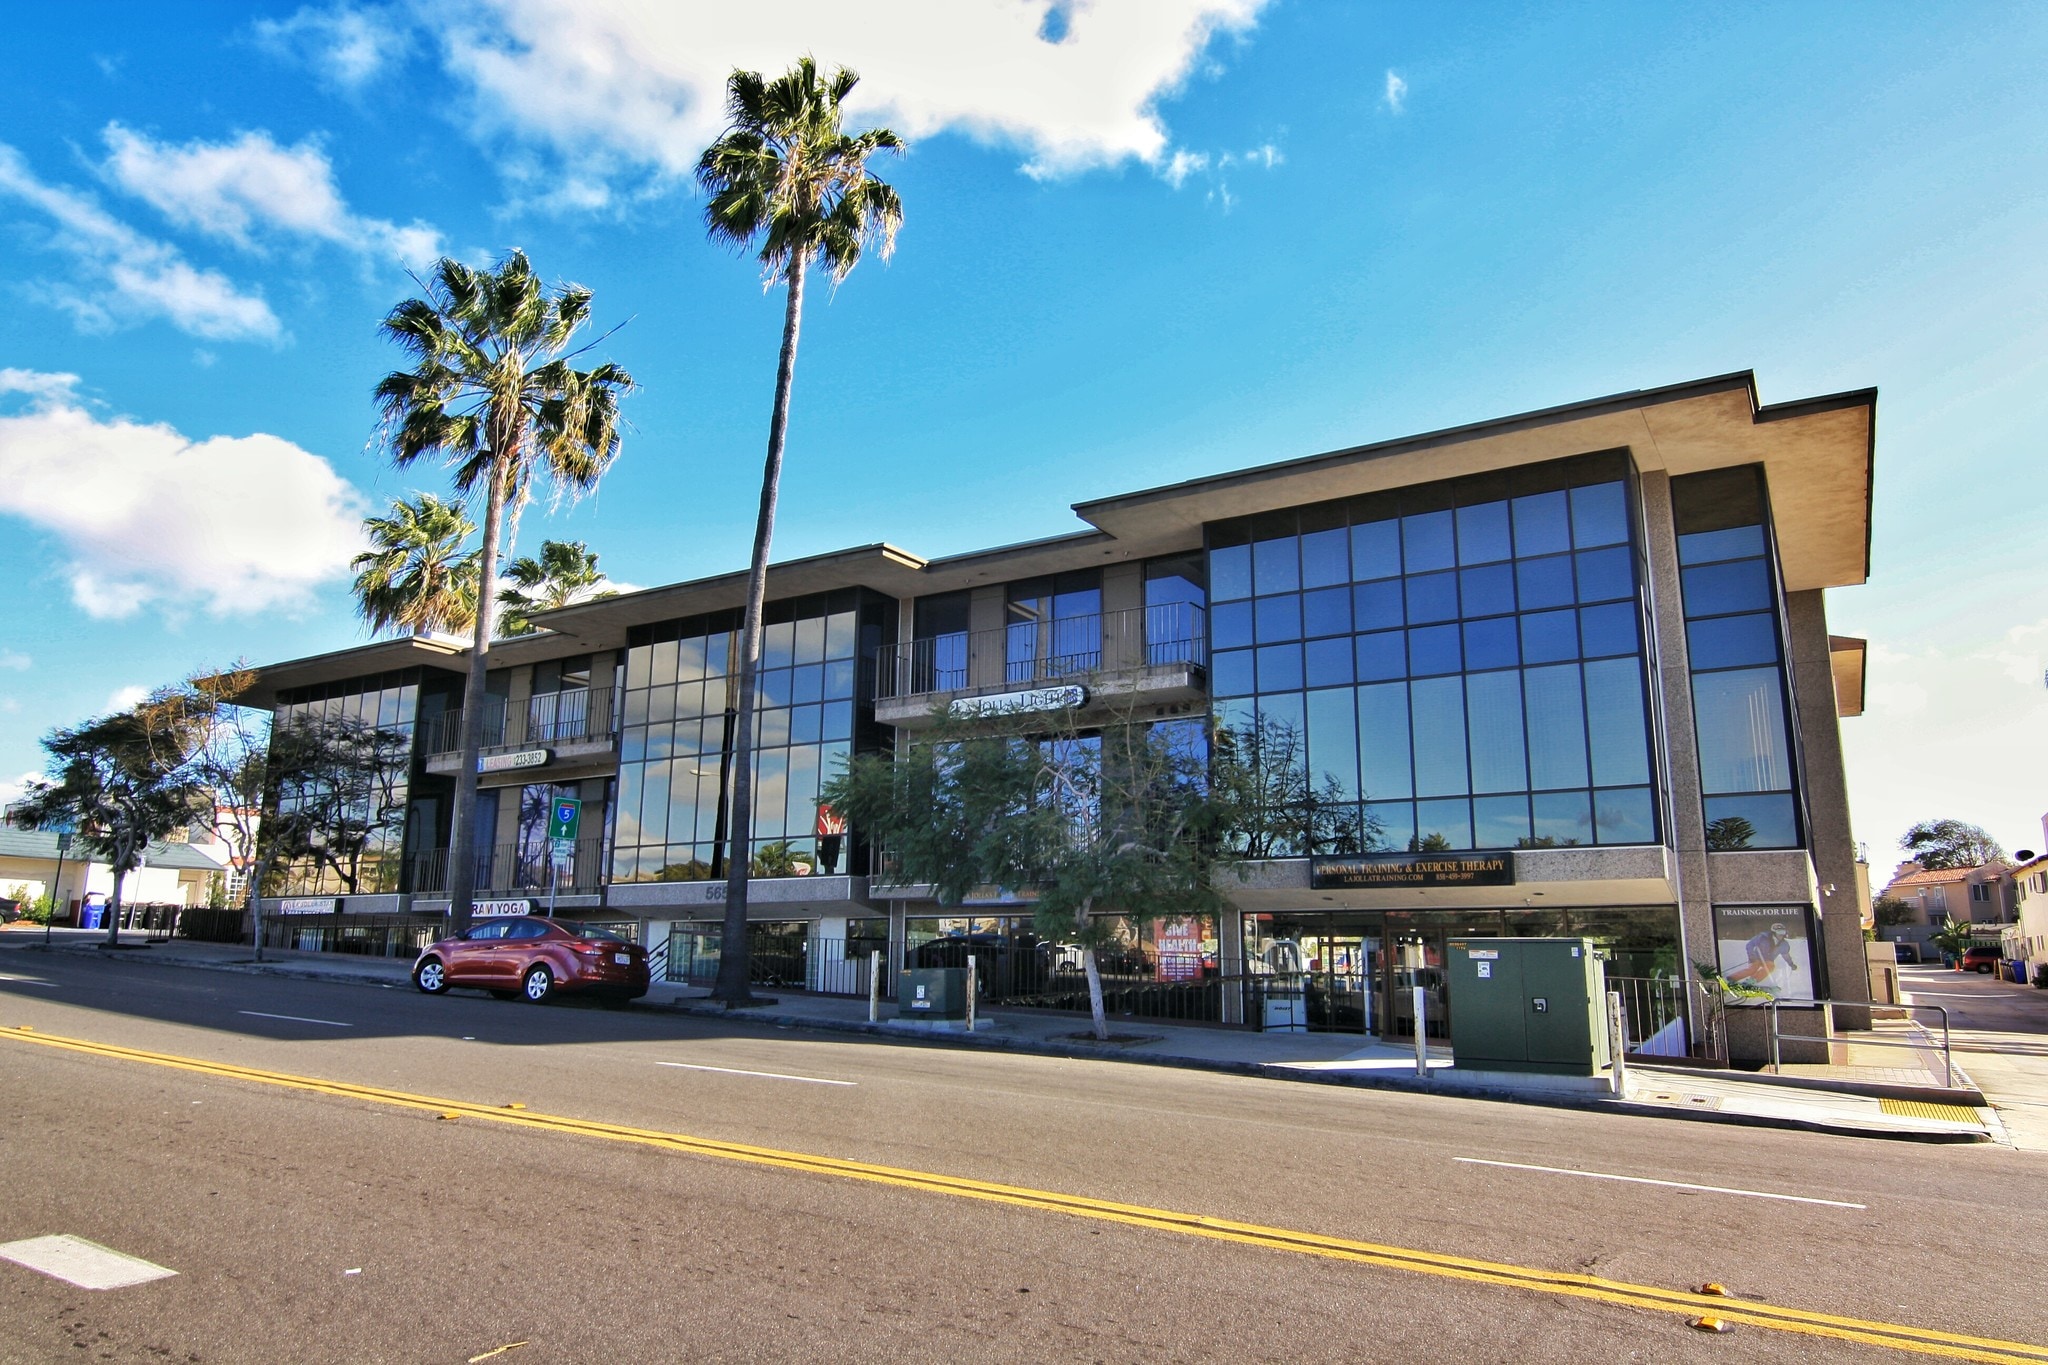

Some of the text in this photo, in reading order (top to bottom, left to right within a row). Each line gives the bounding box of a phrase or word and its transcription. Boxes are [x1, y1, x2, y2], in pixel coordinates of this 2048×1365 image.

[978, 699, 1015, 714] JOLLA
[563, 809, 570, 820] 5
[1316, 860, 1505, 875] PERSONAL TRAINING & EXERCISE THERAPY
[472, 902, 526, 914] RAM YOGA
[1158, 939, 1197, 951] HEALTH
